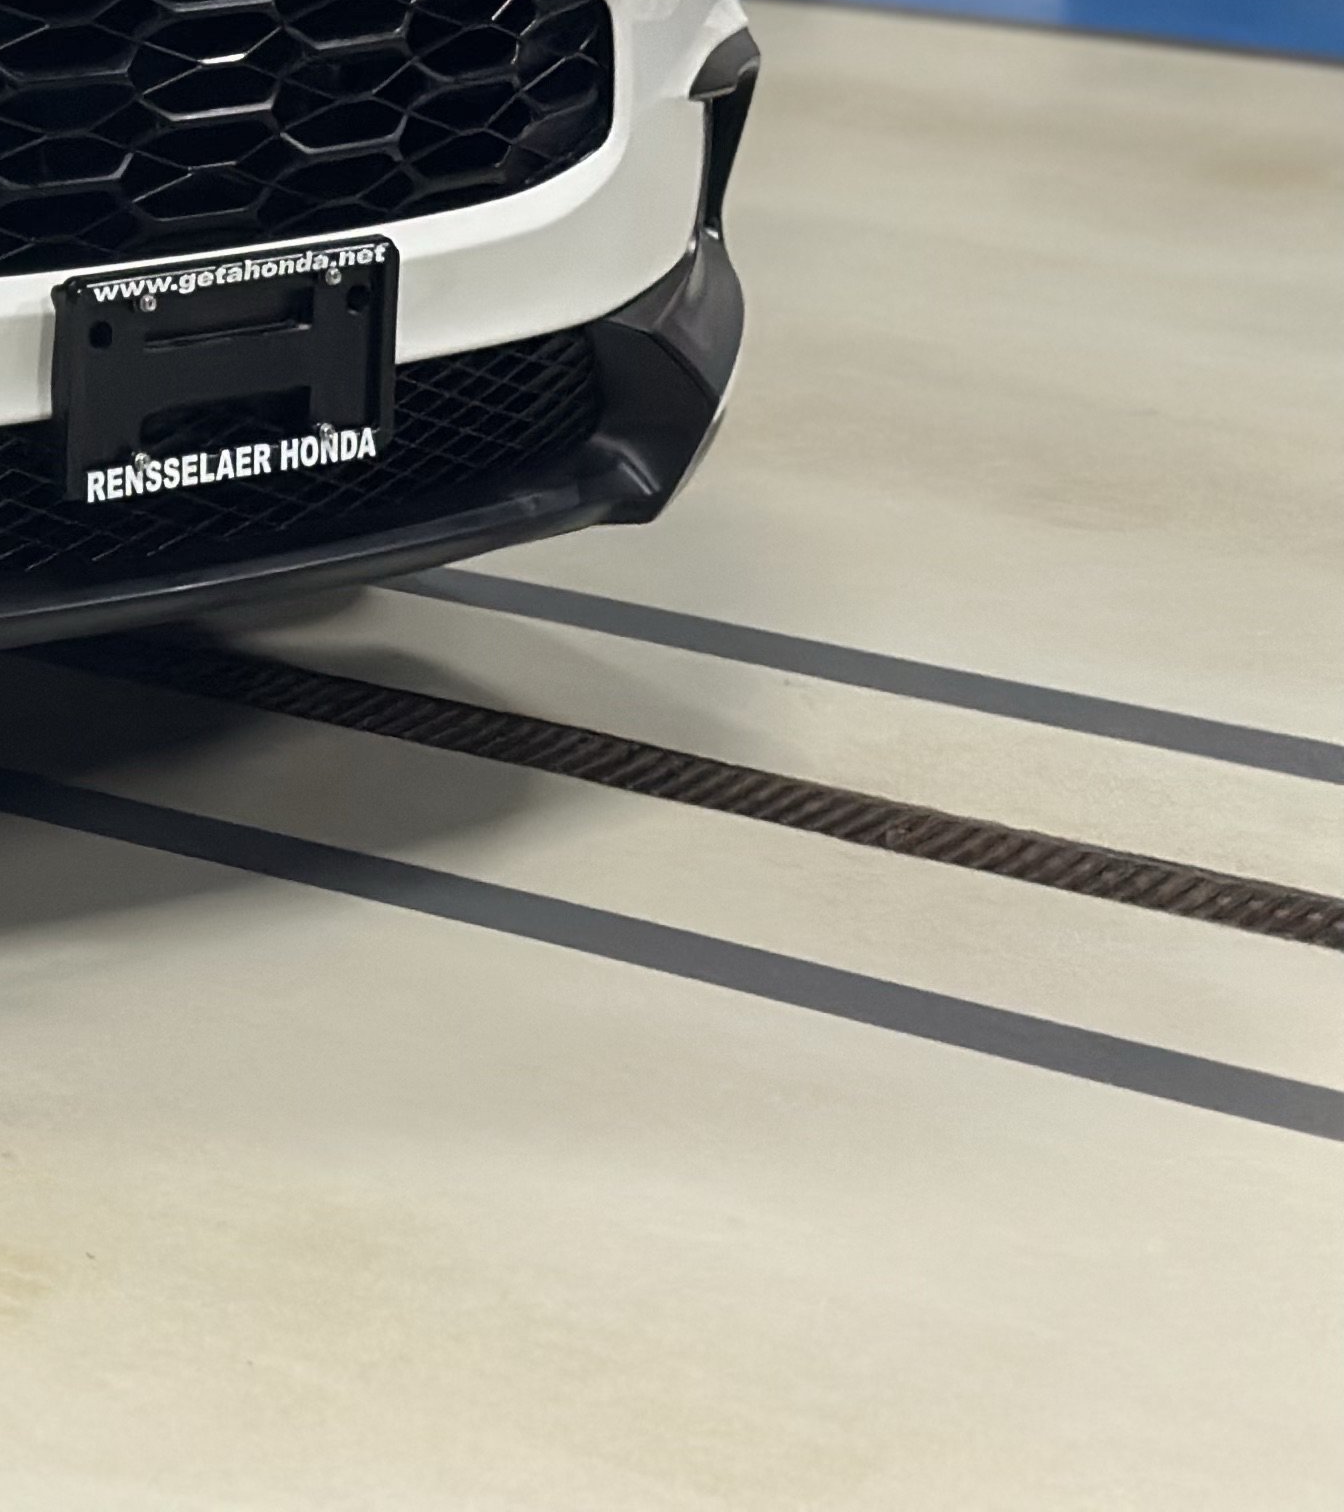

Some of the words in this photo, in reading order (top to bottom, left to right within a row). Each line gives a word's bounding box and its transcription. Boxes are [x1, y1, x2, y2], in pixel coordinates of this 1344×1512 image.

[93, 245, 387, 302] www.getahonda.net
[86, 442, 272, 503] RENSSELAER
[279, 427, 376, 471] HONDA
